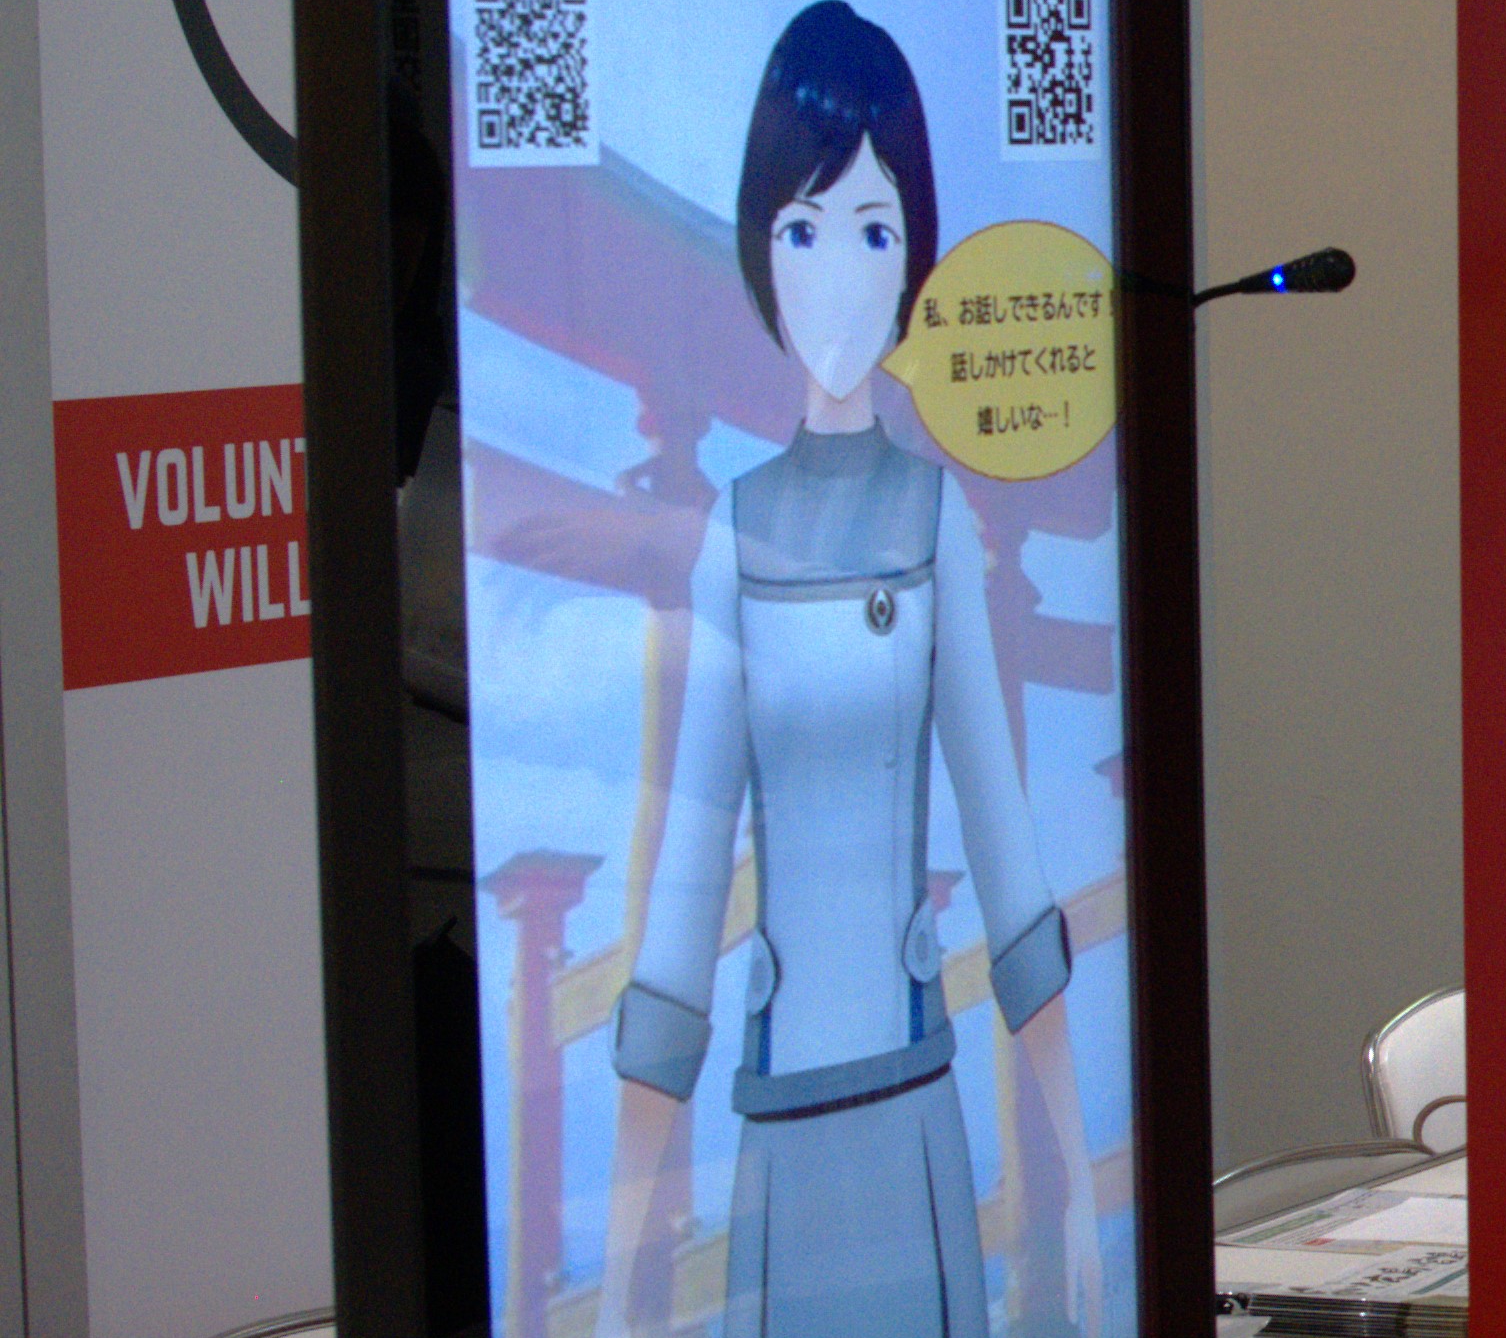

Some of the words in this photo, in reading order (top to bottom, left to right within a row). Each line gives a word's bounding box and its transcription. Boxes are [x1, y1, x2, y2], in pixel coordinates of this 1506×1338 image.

[951, 344, 1096, 383] 話しかけてくれると
[186, 540, 312, 629] WILL
